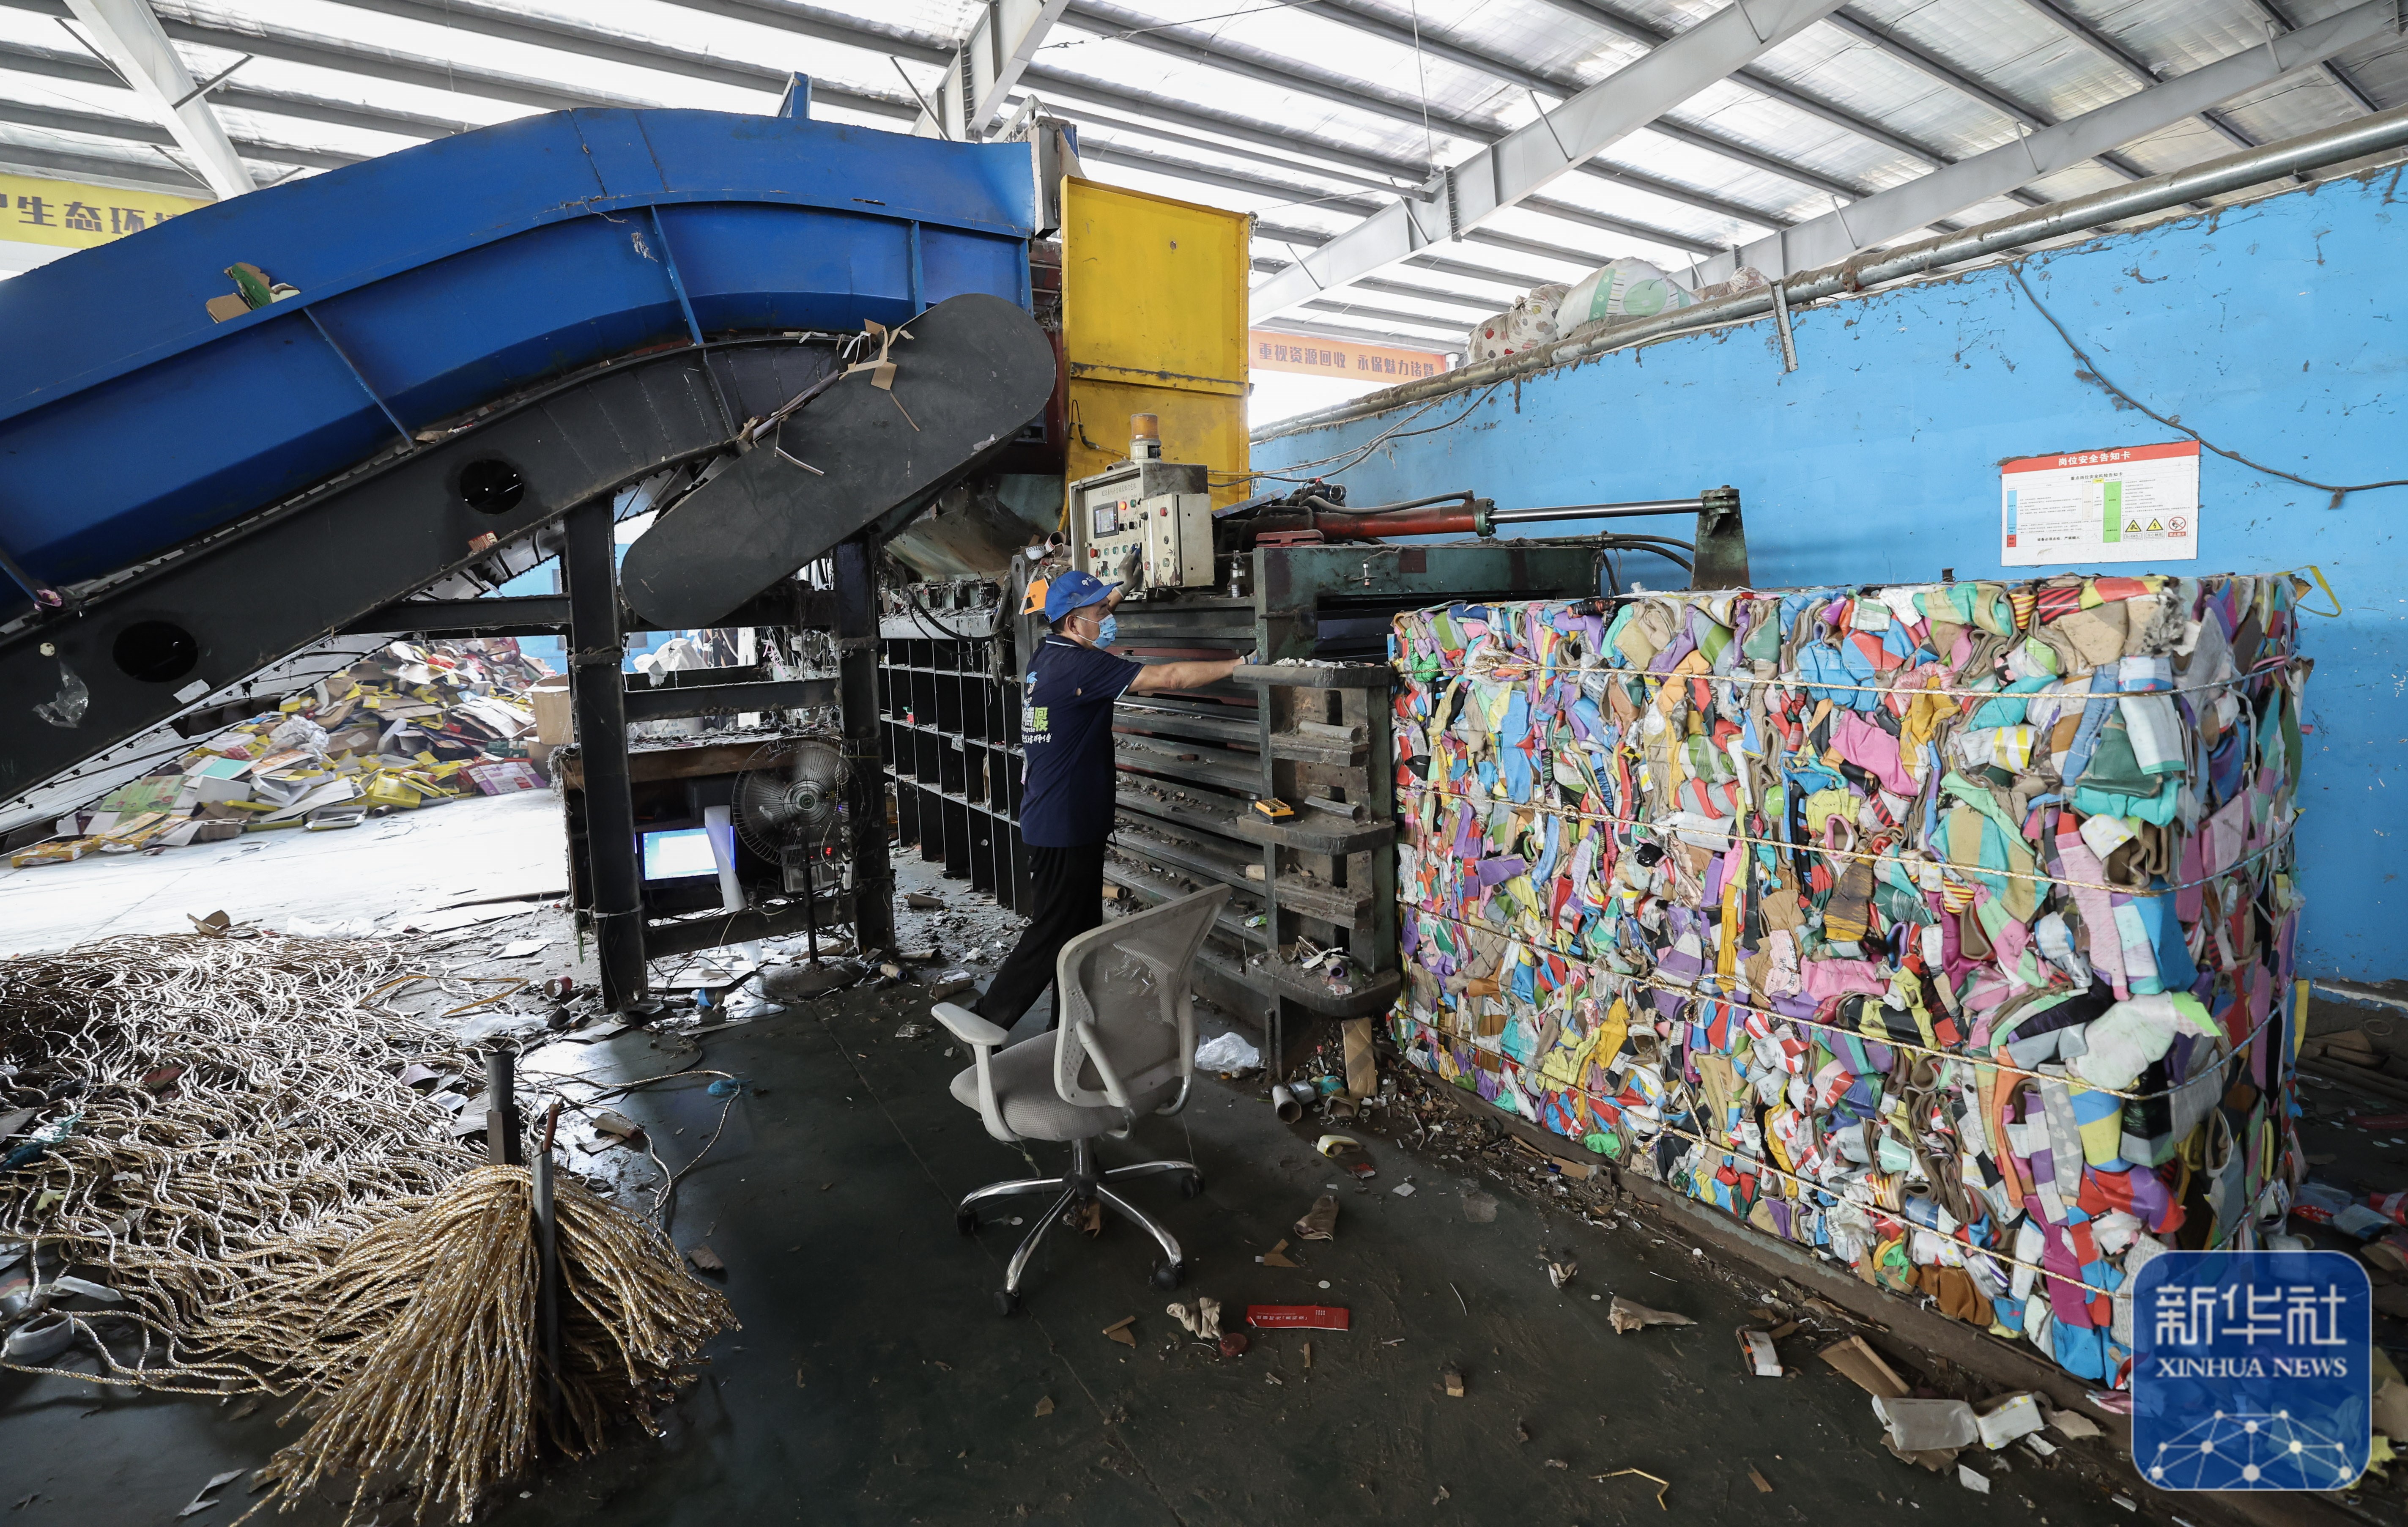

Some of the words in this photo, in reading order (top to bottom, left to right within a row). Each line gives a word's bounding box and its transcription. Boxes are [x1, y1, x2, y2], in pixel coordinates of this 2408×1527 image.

[0, 193, 180, 235] 生态环
[1258, 343, 1346, 368] 重视资源回收
[1357, 354, 1434, 378] 永保魅力诸暨
[2058, 451, 2131, 466] 岗位安全告知卡
[2071, 472, 2123, 481] 重点岗位安全风险告知卡
